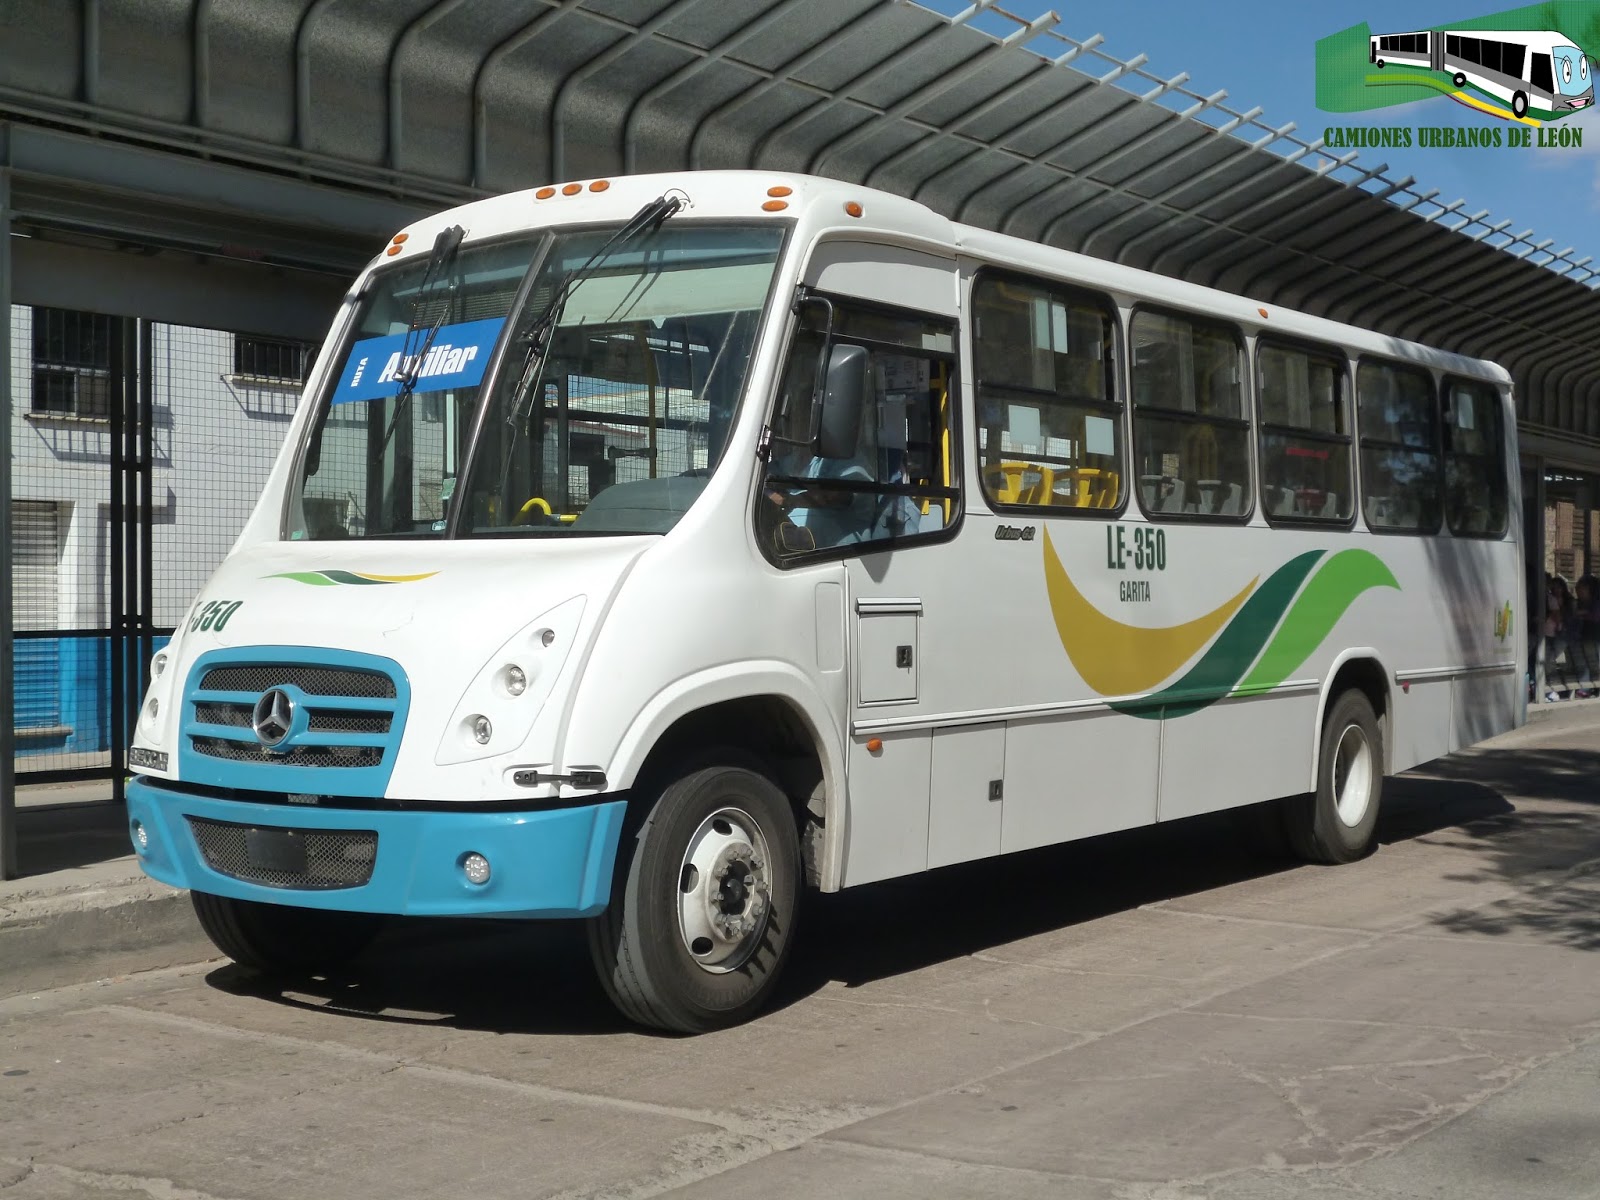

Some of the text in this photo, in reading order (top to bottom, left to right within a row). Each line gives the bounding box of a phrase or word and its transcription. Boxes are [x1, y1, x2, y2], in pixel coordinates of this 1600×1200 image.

[350, 357, 368, 387] RUTA
[1106, 525, 1166, 571] LE-350
[1119, 581, 1151, 602] GARITA
